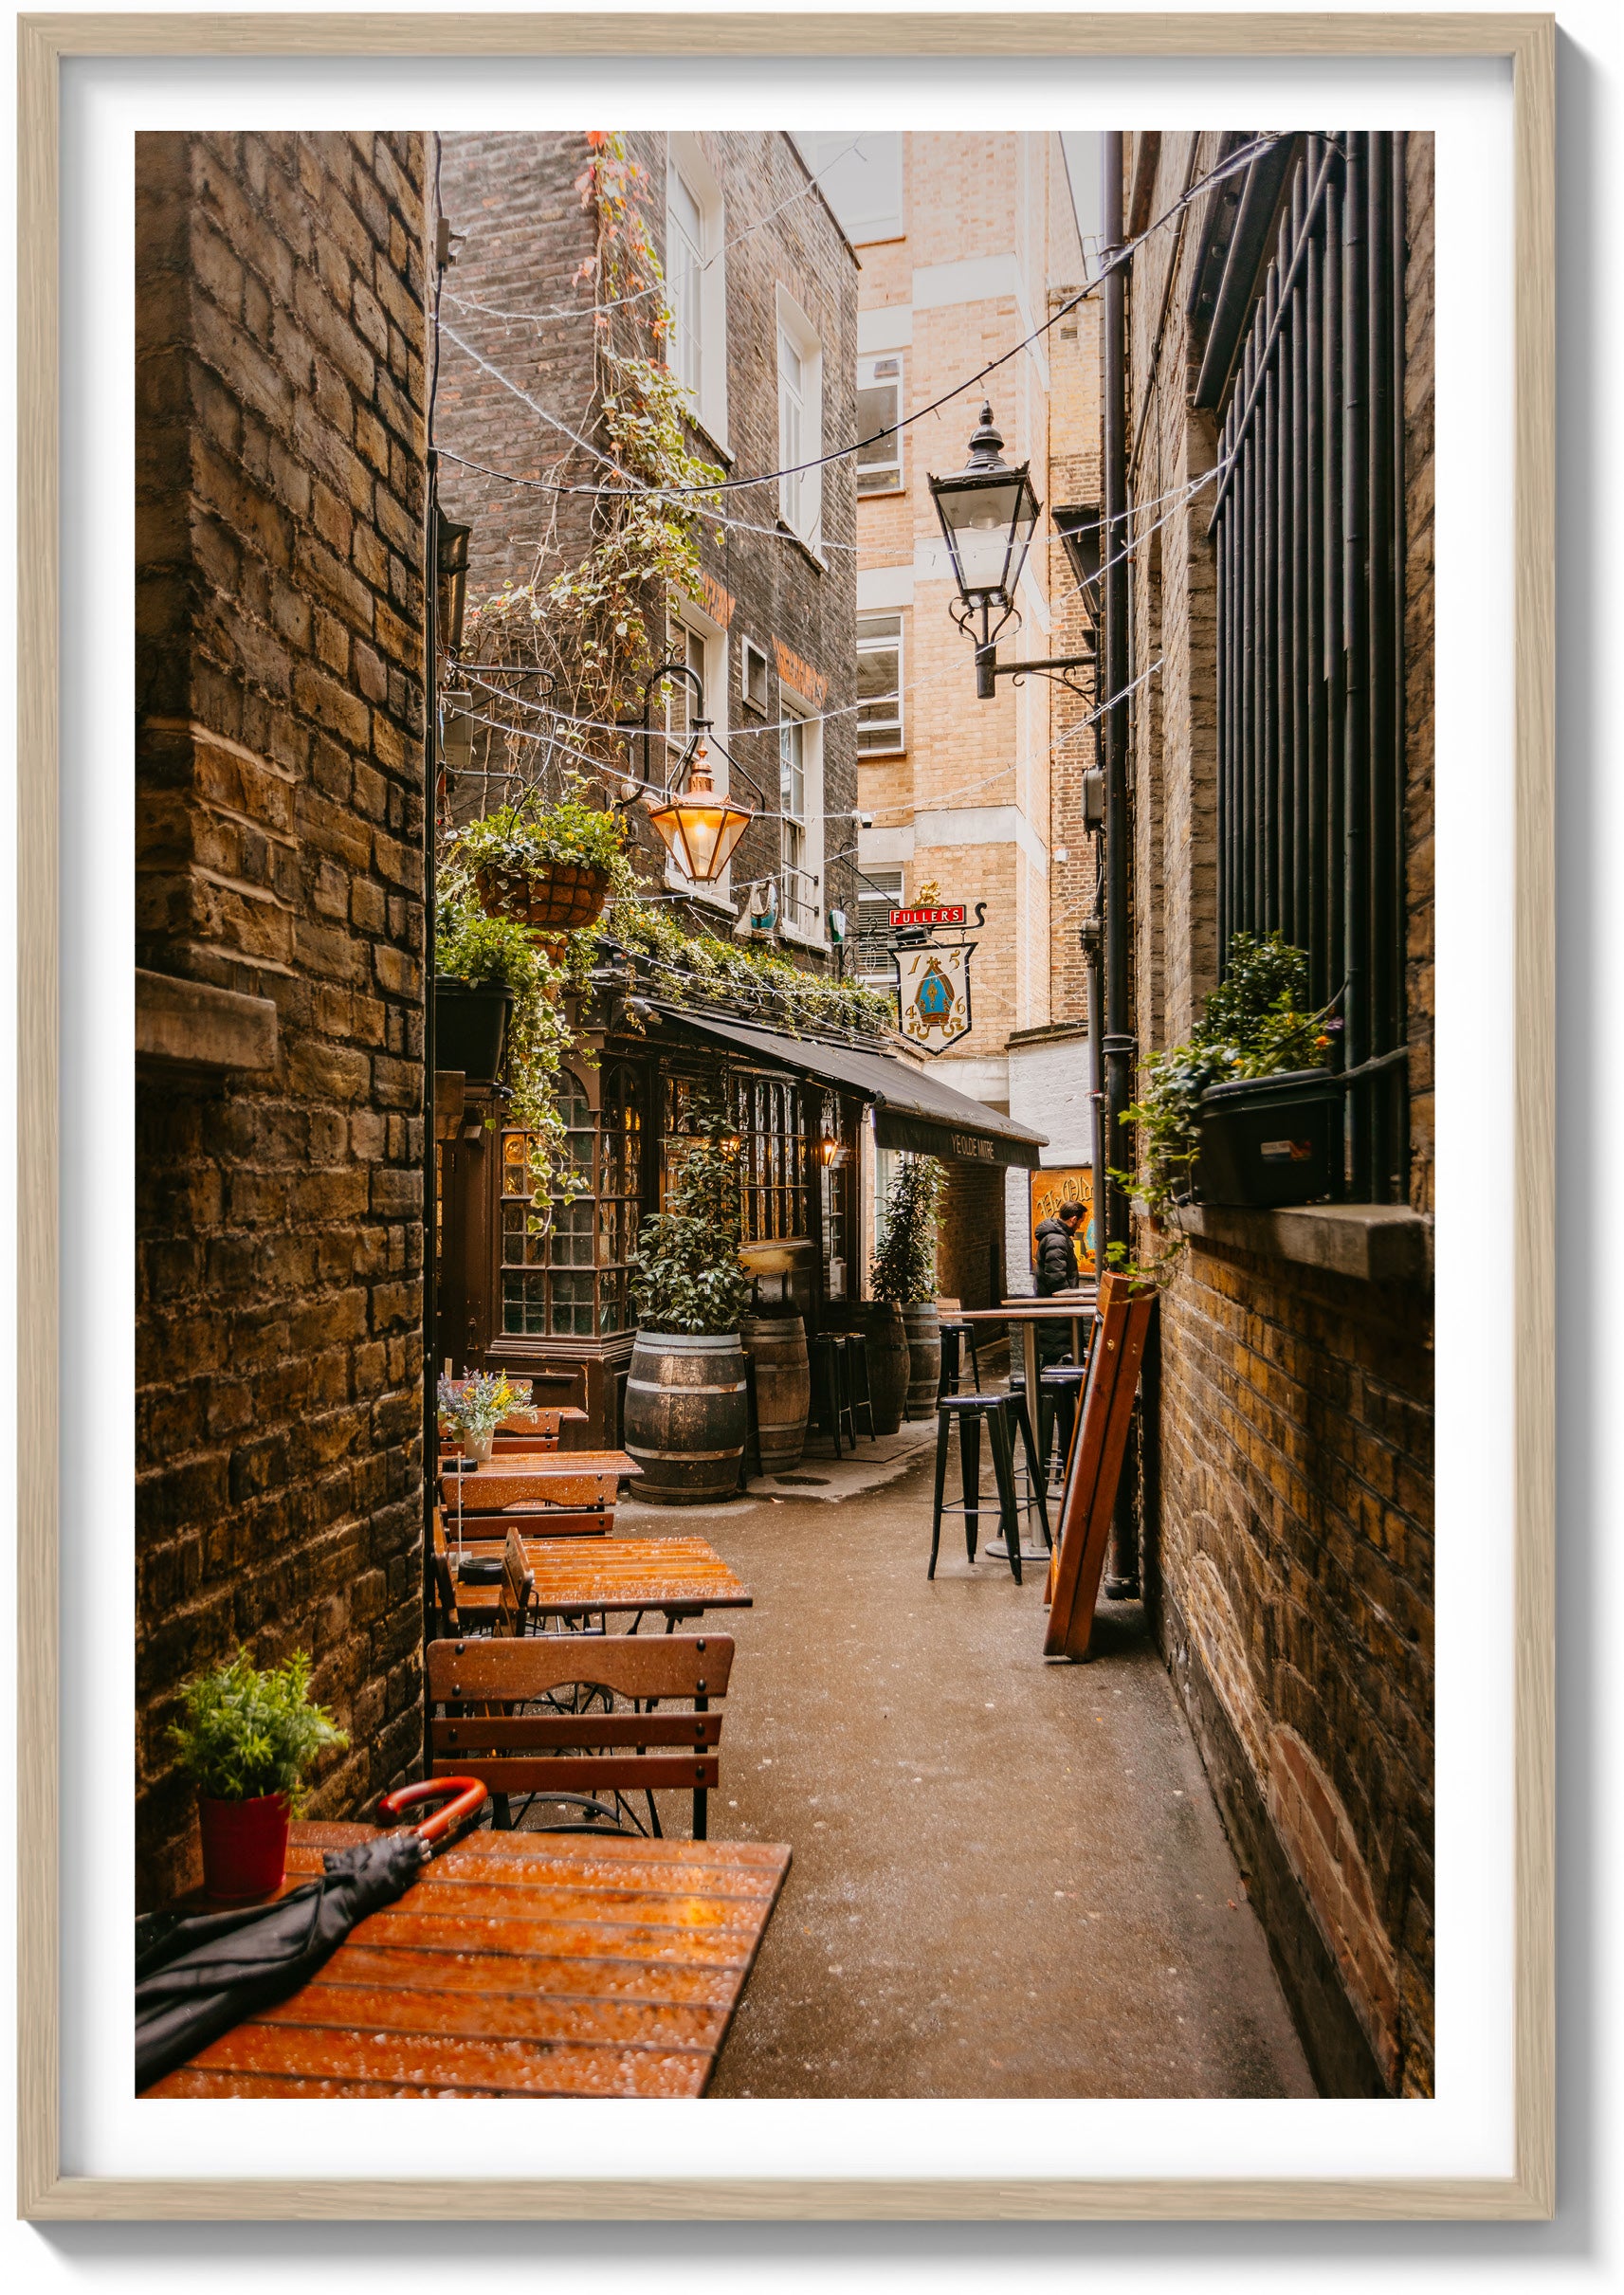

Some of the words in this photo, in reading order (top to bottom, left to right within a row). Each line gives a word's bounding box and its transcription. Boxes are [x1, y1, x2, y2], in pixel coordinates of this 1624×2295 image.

[893, 909, 959, 923] FULLER'S
[907, 955, 921, 975] 1
[949, 949, 961, 970] 5
[904, 1005, 917, 1019] 4
[955, 996, 966, 1015] 6
[952, 1134, 961, 1154] YE
[961, 1136, 977, 1157] OLDE
[1062, 1176, 1094, 1202] Old
